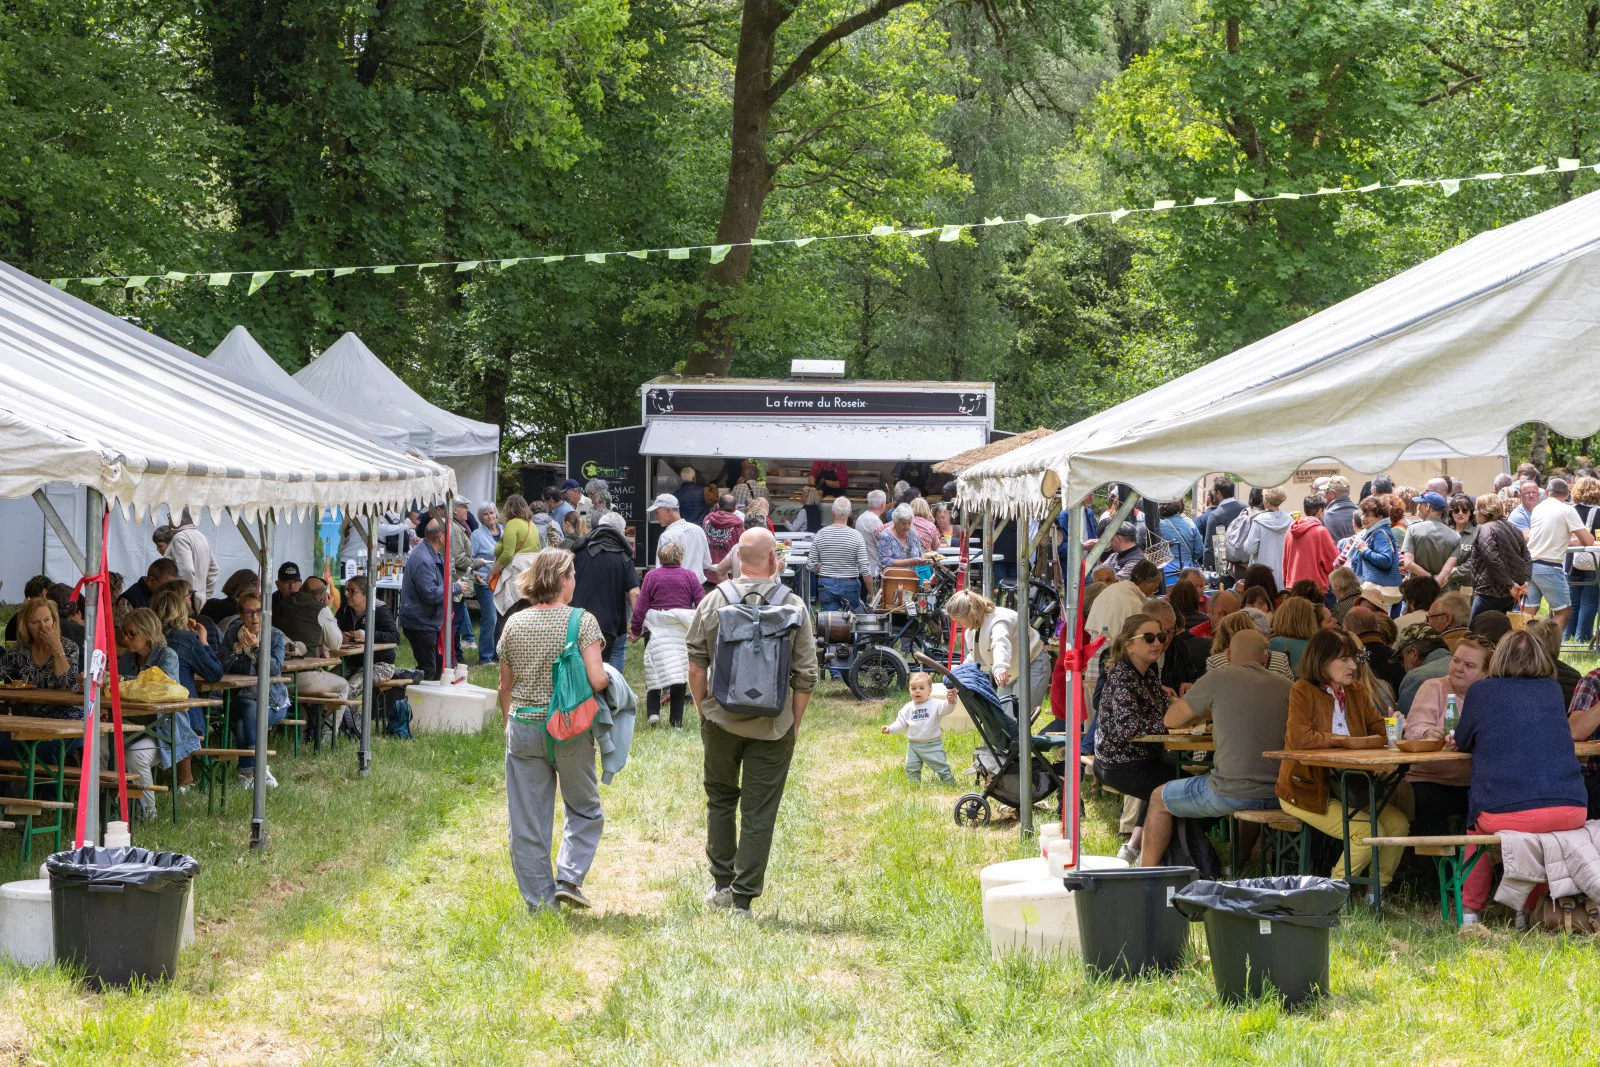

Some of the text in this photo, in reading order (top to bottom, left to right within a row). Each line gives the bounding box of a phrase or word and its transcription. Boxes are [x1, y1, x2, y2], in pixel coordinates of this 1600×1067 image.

[766, 395, 866, 408] La ferme du Roseix
